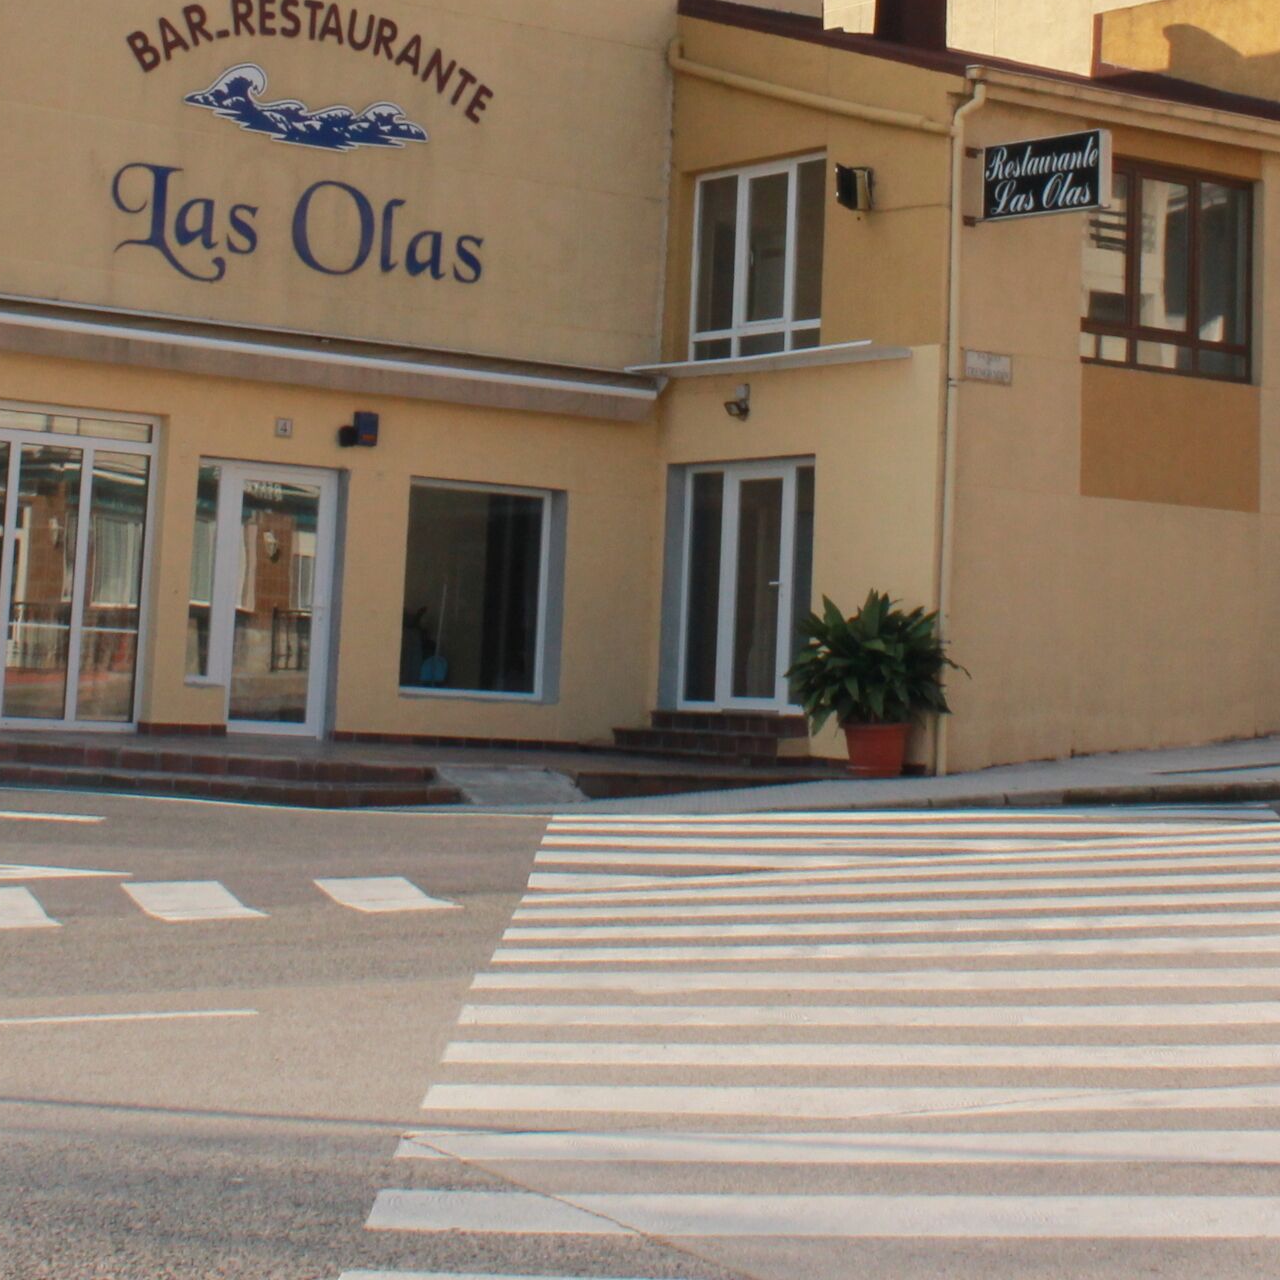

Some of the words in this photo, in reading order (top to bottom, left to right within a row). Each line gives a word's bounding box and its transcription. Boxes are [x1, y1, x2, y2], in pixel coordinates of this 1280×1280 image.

[985, 136, 1098, 181] Restaurante
[993, 180, 1035, 214] Las
[1042, 173, 1091, 207] Olas
[111, 162, 259, 284] Las
[291, 181, 485, 284] Olas
